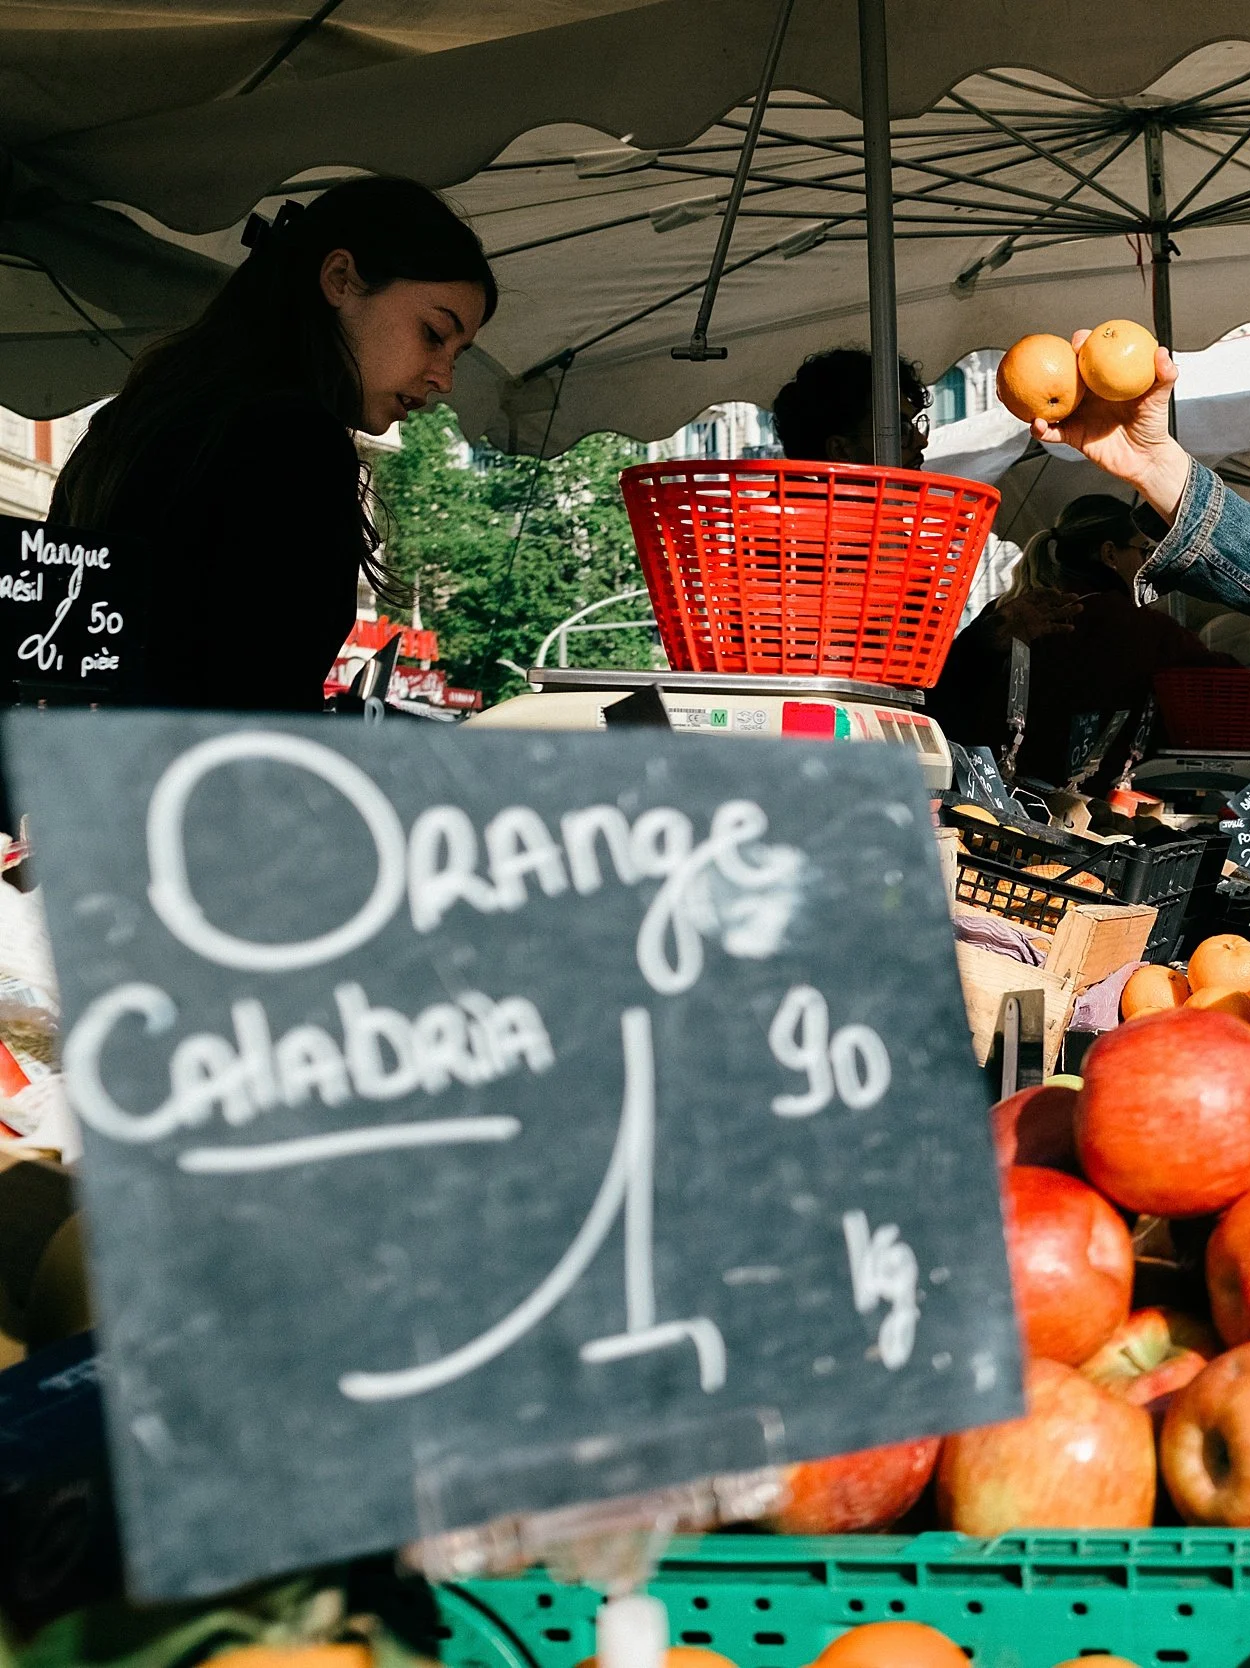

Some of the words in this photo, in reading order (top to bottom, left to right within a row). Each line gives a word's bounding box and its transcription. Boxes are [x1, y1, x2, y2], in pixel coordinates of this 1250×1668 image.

[21, 528, 111, 600] Mangue
[87, 601, 124, 634] 50
[713, 712, 725, 724] M
[767, 983, 892, 1117] 90
